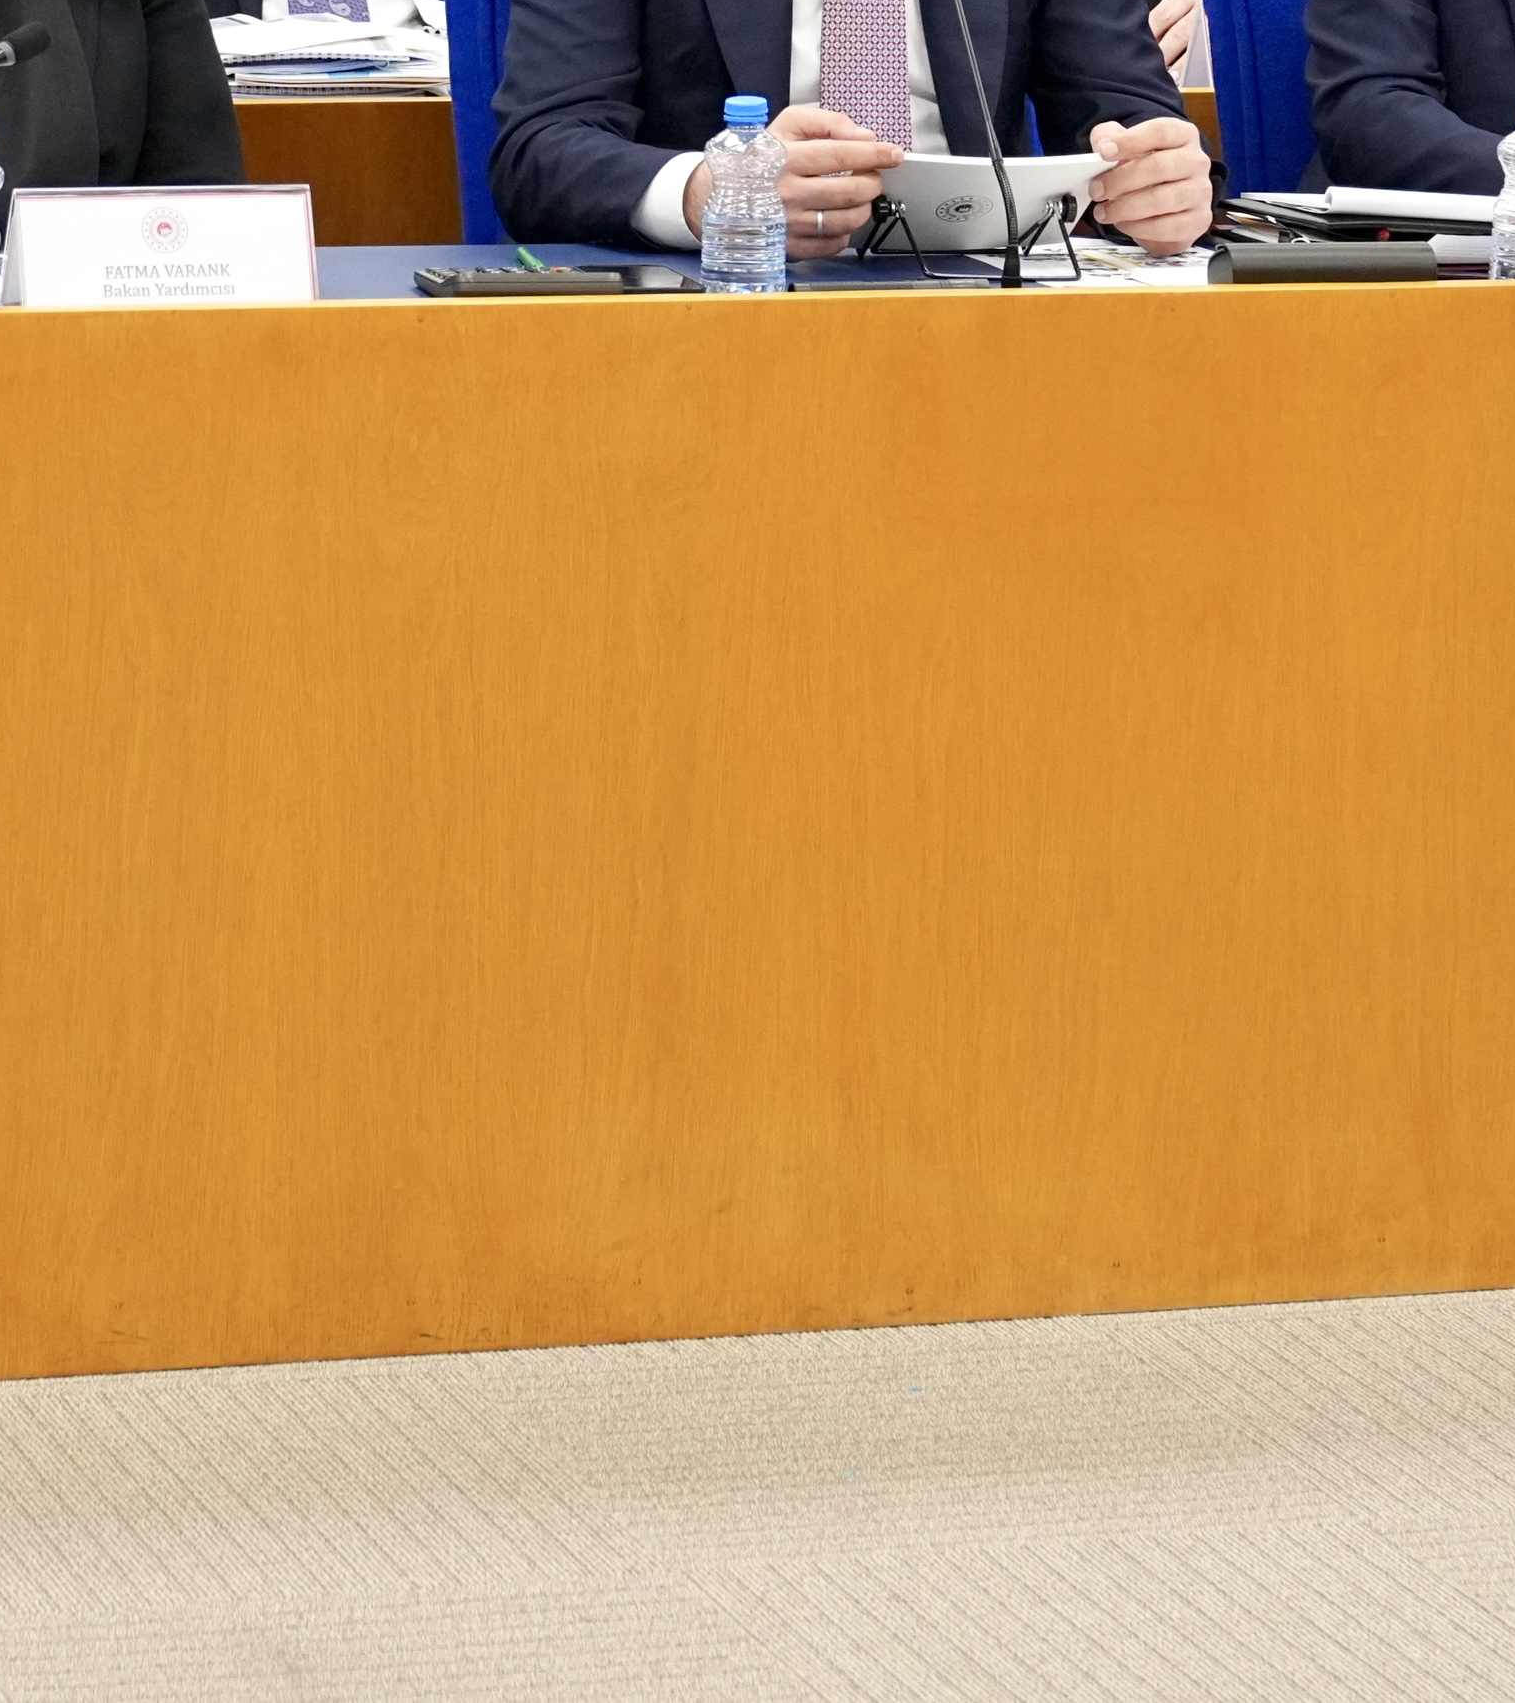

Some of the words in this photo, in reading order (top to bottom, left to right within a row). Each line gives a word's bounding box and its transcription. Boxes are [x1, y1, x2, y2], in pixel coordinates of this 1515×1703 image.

[105, 265, 160, 280] FATMA
[163, 263, 231, 278] VARANK
[103, 283, 151, 298] Bakan
[154, 282, 236, 297] Yardımcısı
